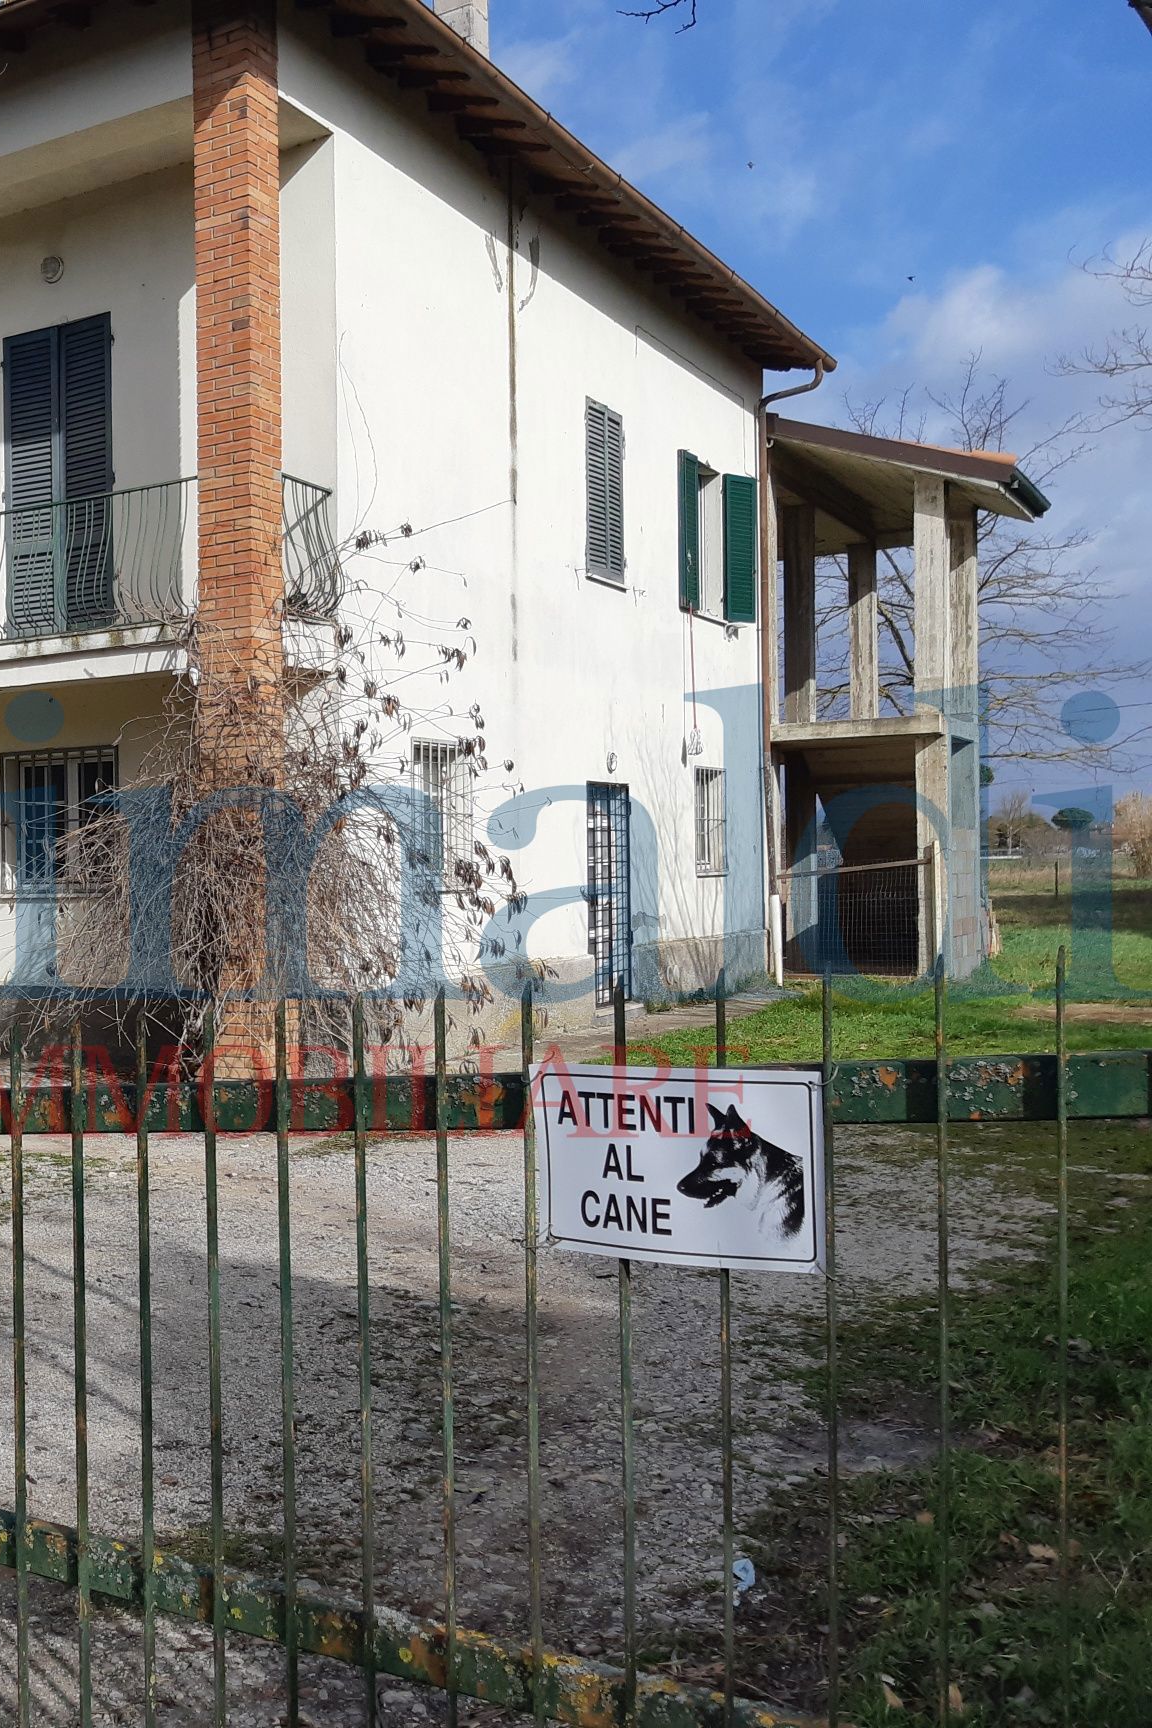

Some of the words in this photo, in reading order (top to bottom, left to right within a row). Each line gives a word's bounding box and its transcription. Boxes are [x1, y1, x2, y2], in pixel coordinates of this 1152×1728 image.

[557, 1089, 696, 1135] ATTENTI
[602, 1143, 645, 1183] AL
[580, 1189, 673, 1236] CANE
